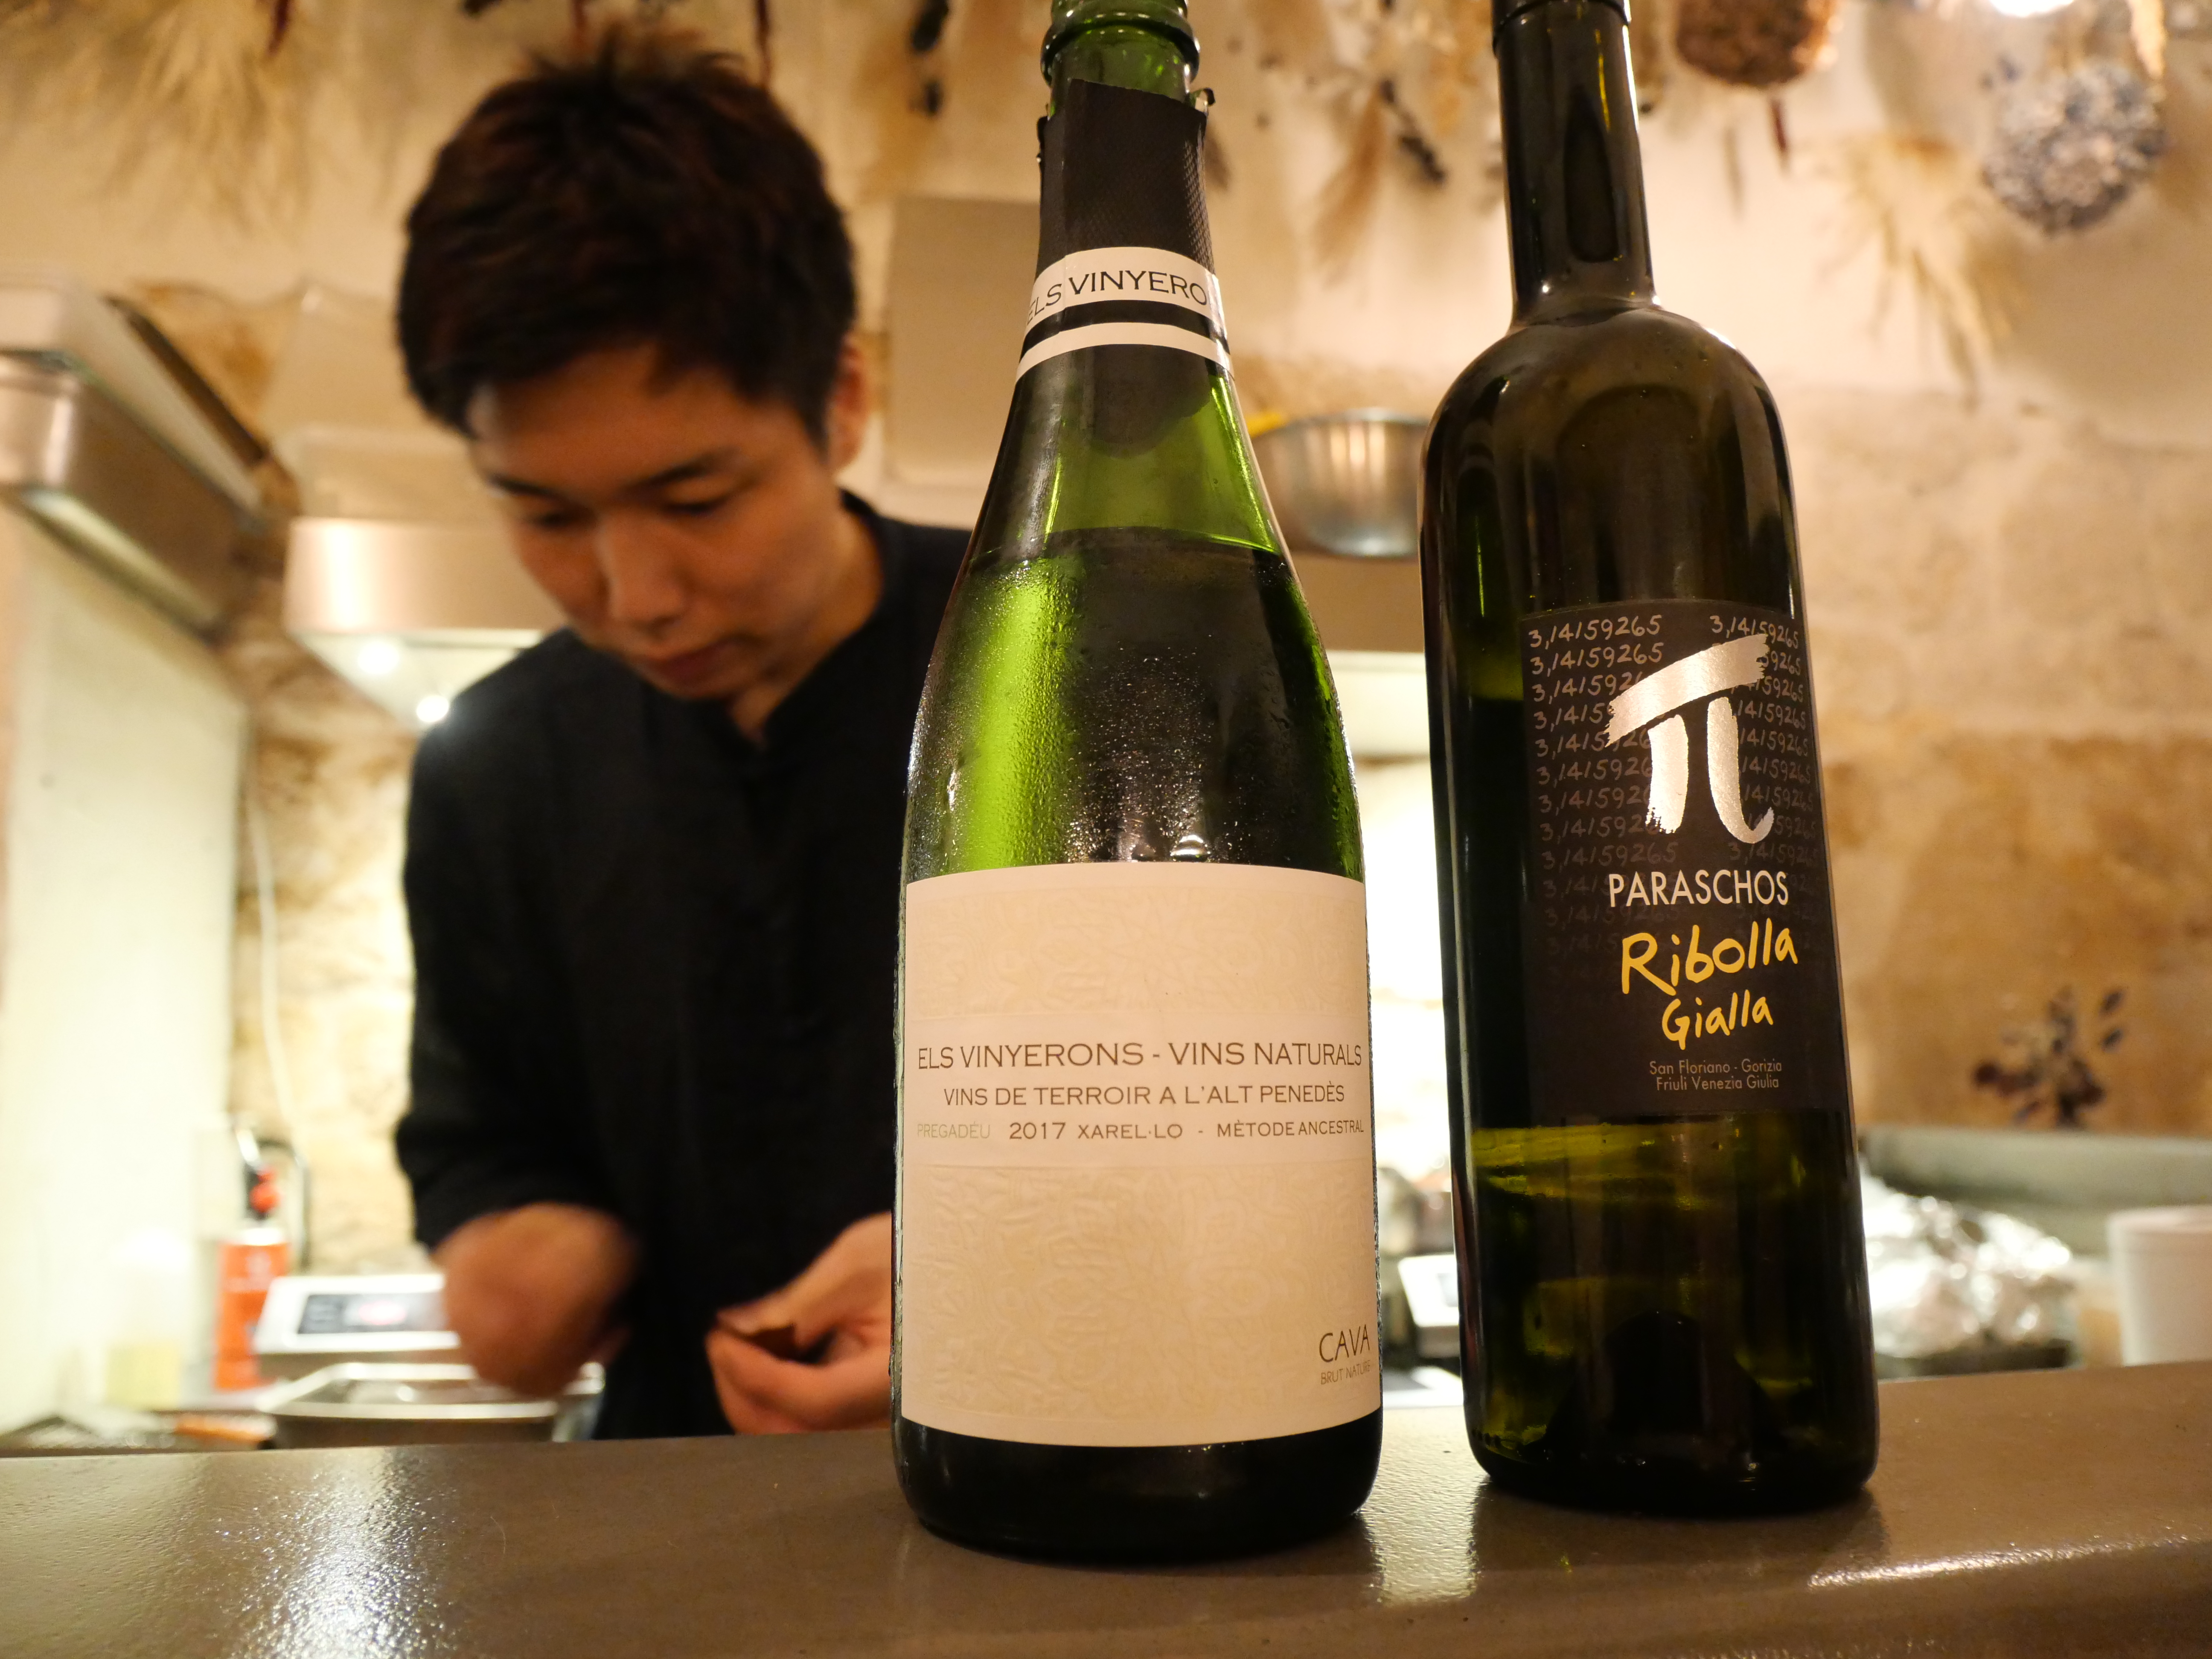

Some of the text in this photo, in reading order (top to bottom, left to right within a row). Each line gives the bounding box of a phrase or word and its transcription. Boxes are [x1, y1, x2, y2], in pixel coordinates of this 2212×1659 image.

[1027, 270, 1208, 325] ELS VINYERO
[1528, 614, 1662, 650] 3,14159265
[1530, 642, 1664, 677] 3,14159265
[1735, 699, 1806, 730] 14159265
[1608, 869, 1789, 908] PARASCHOS
[1621, 917, 1798, 996] Ribolla
[1661, 989, 1773, 1050] Gialla
[918, 1047, 954, 1069] ELS
[960, 1042, 1144, 1068] VINYERONS
[1168, 1042, 1245, 1065] VINS
[1254, 1042, 1362, 1066] NATURALS
[1649, 1060, 1674, 1075] San
[1679, 1059, 1731, 1074] Floriano
[1741, 1058, 1782, 1073] Gorizia
[943, 1081, 1345, 1106] VINS DE TERROIR A L'ALT PENEDÈS
[1656, 1073, 1779, 1091] Friuli Venezia Giulia
[917, 1121, 990, 1139] PREGADÉU
[1009, 1122, 1066, 1140] 2017
[1217, 1120, 1295, 1138] MÈTODE
[1298, 1119, 1364, 1136] ANCESTRAL
[1319, 1324, 1370, 1362] CAVA
[1321, 1359, 1371, 1385] BRUT NATURE
